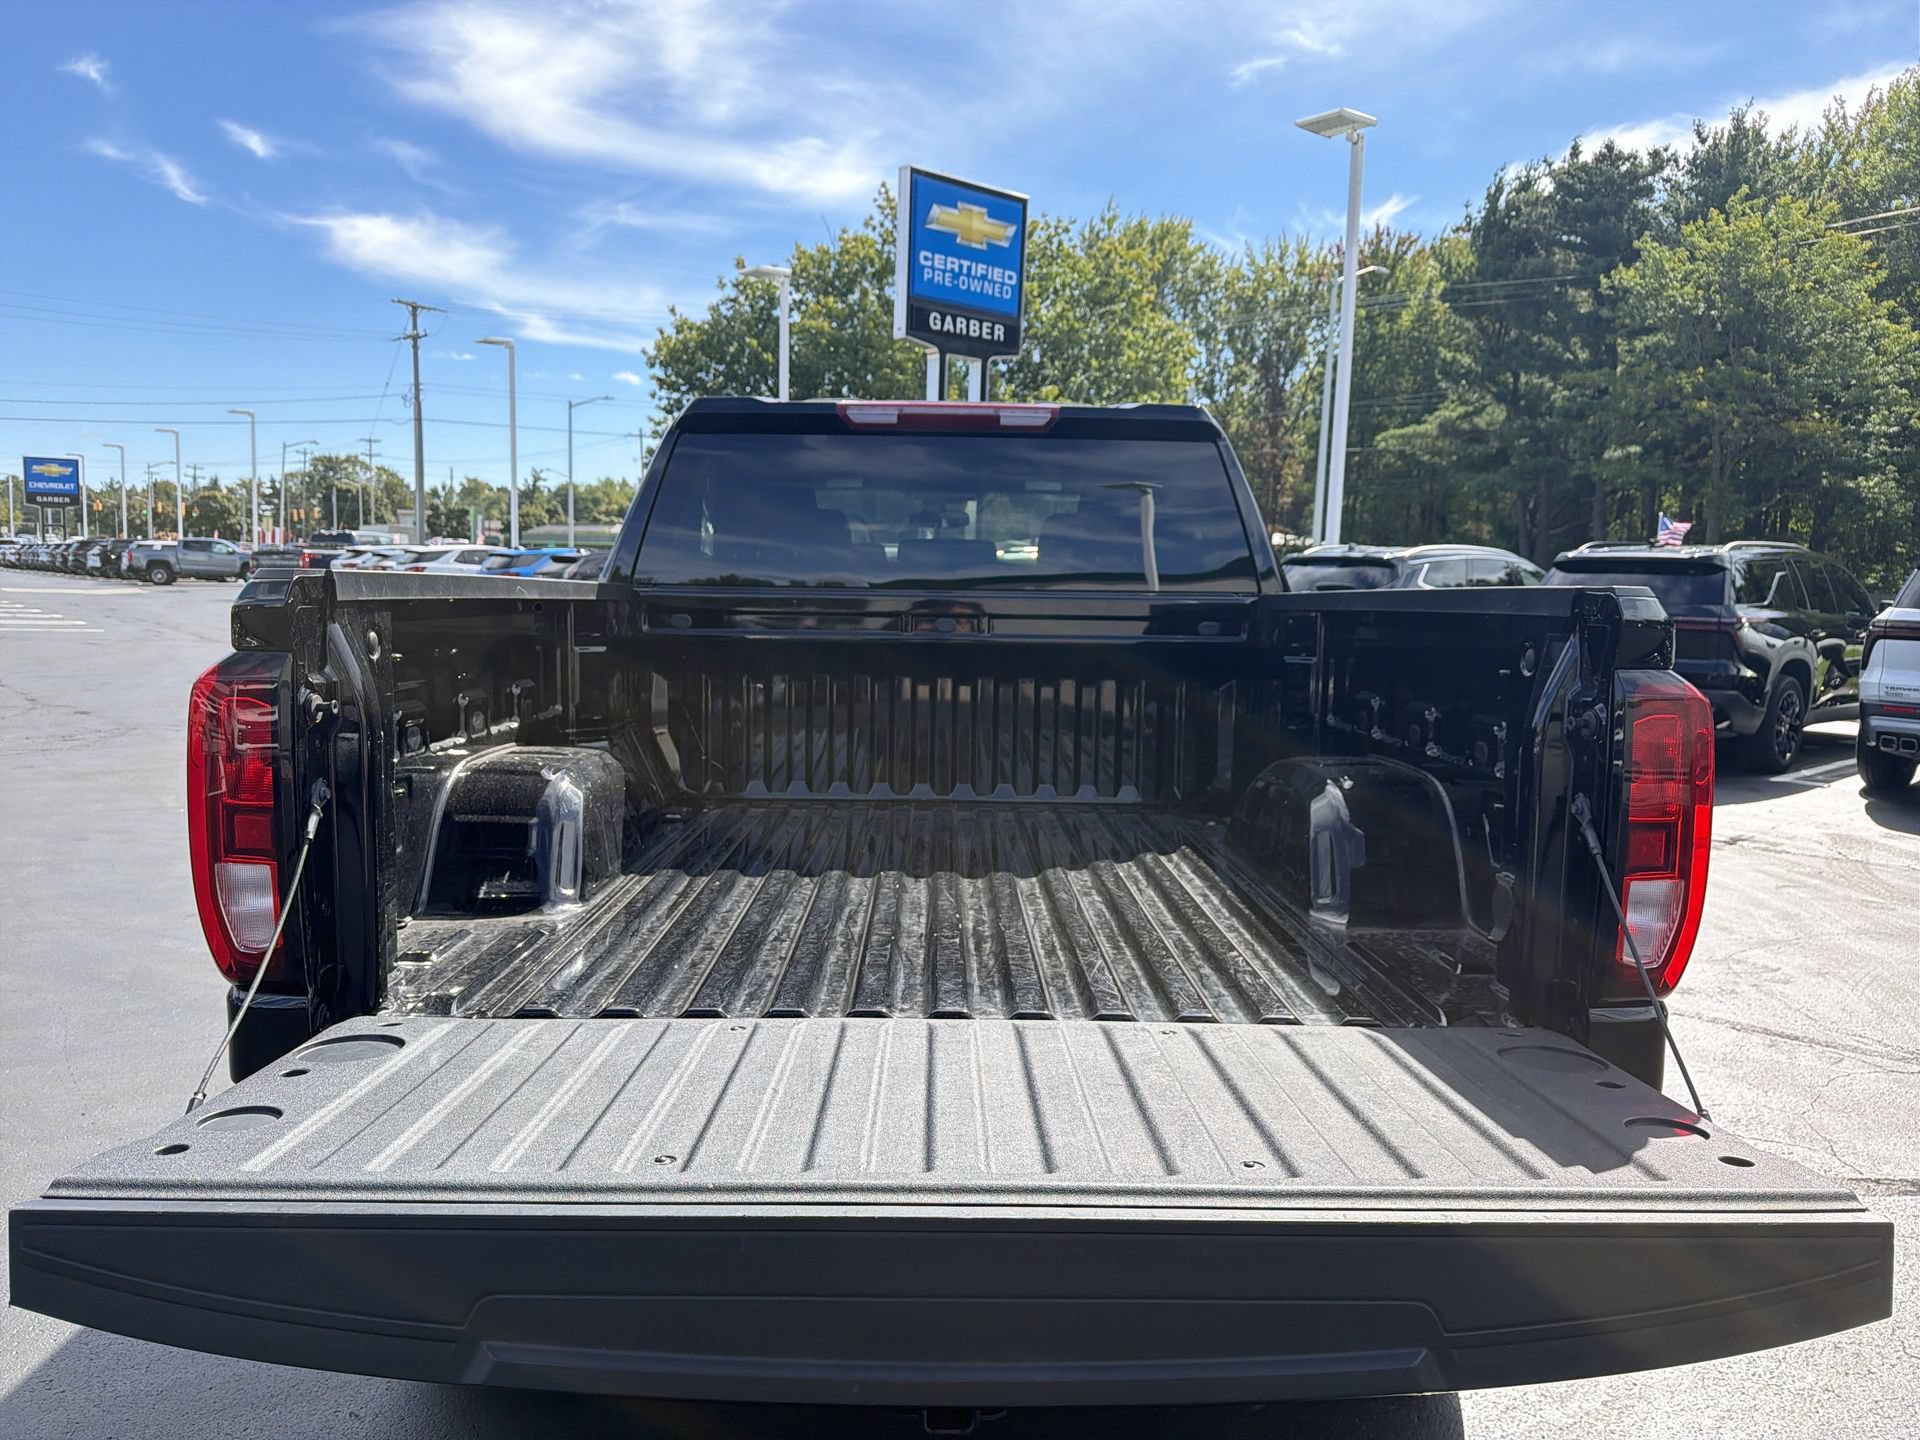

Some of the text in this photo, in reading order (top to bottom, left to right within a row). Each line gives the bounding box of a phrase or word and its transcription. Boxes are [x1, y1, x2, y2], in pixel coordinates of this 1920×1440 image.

[919, 251, 1017, 285] CERTIFIED
[923, 269, 1012, 300] PRE-OWNED
[929, 311, 1005, 342] GARBER
[28, 481, 75, 490] CHEVROLET
[36, 495, 70, 504] GARBER
